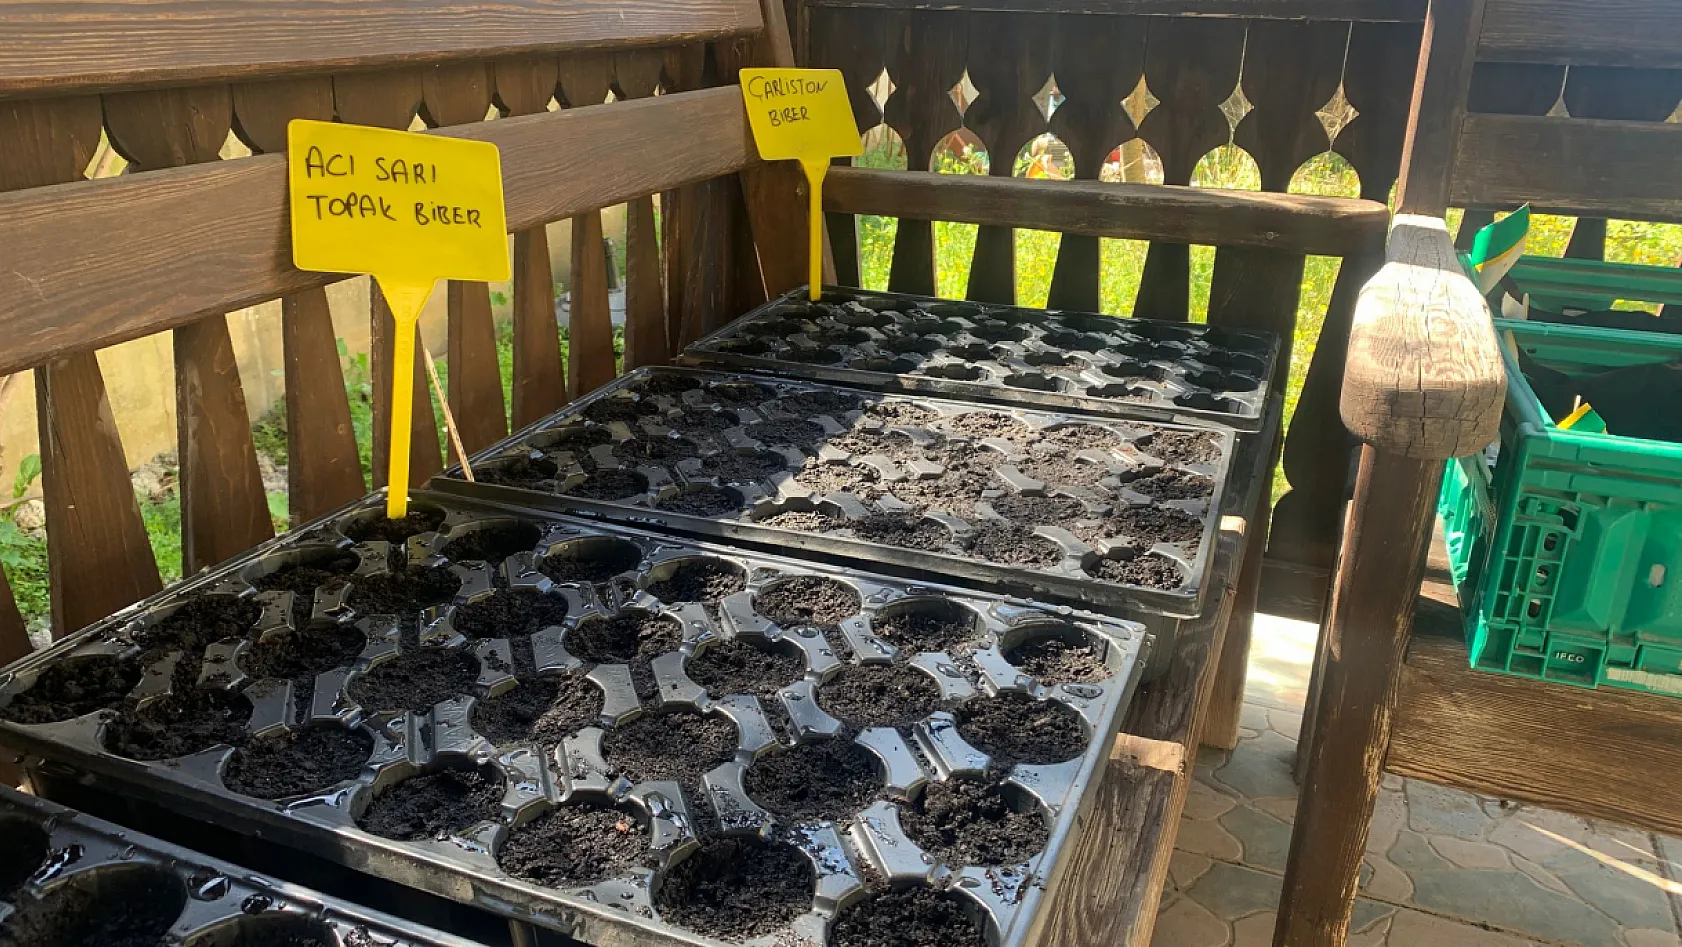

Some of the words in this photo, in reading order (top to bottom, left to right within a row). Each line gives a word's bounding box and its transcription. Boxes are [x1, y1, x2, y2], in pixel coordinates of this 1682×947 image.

[305, 145, 355, 178] ACI
[375, 157, 436, 184] SARI
[1555, 652, 1585, 663] IFCO
